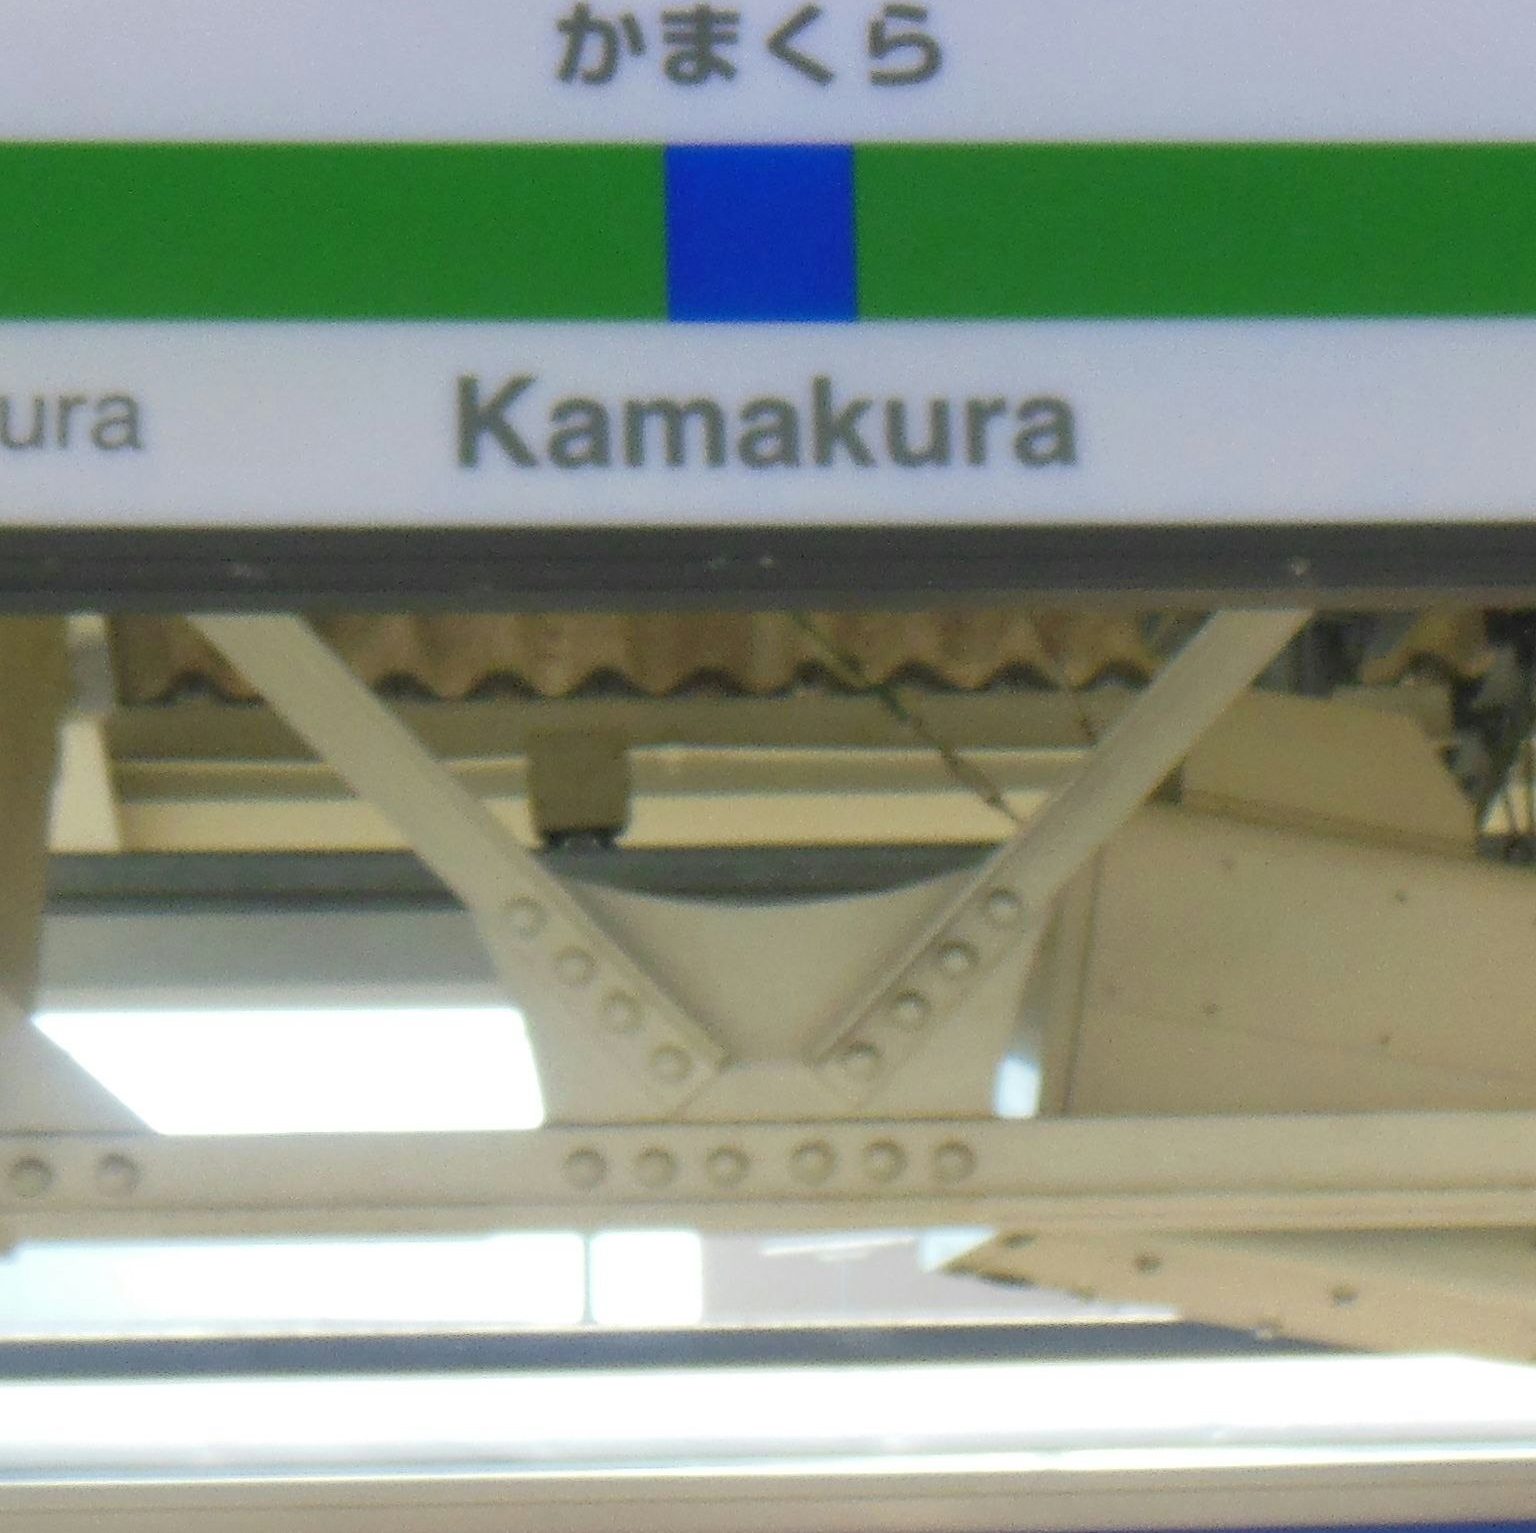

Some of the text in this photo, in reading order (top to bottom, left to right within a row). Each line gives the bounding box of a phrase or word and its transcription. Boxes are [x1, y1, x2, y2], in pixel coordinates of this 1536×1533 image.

[557, 3, 944, 89] かまくら
[457, 375, 1078, 471] Kamakura
